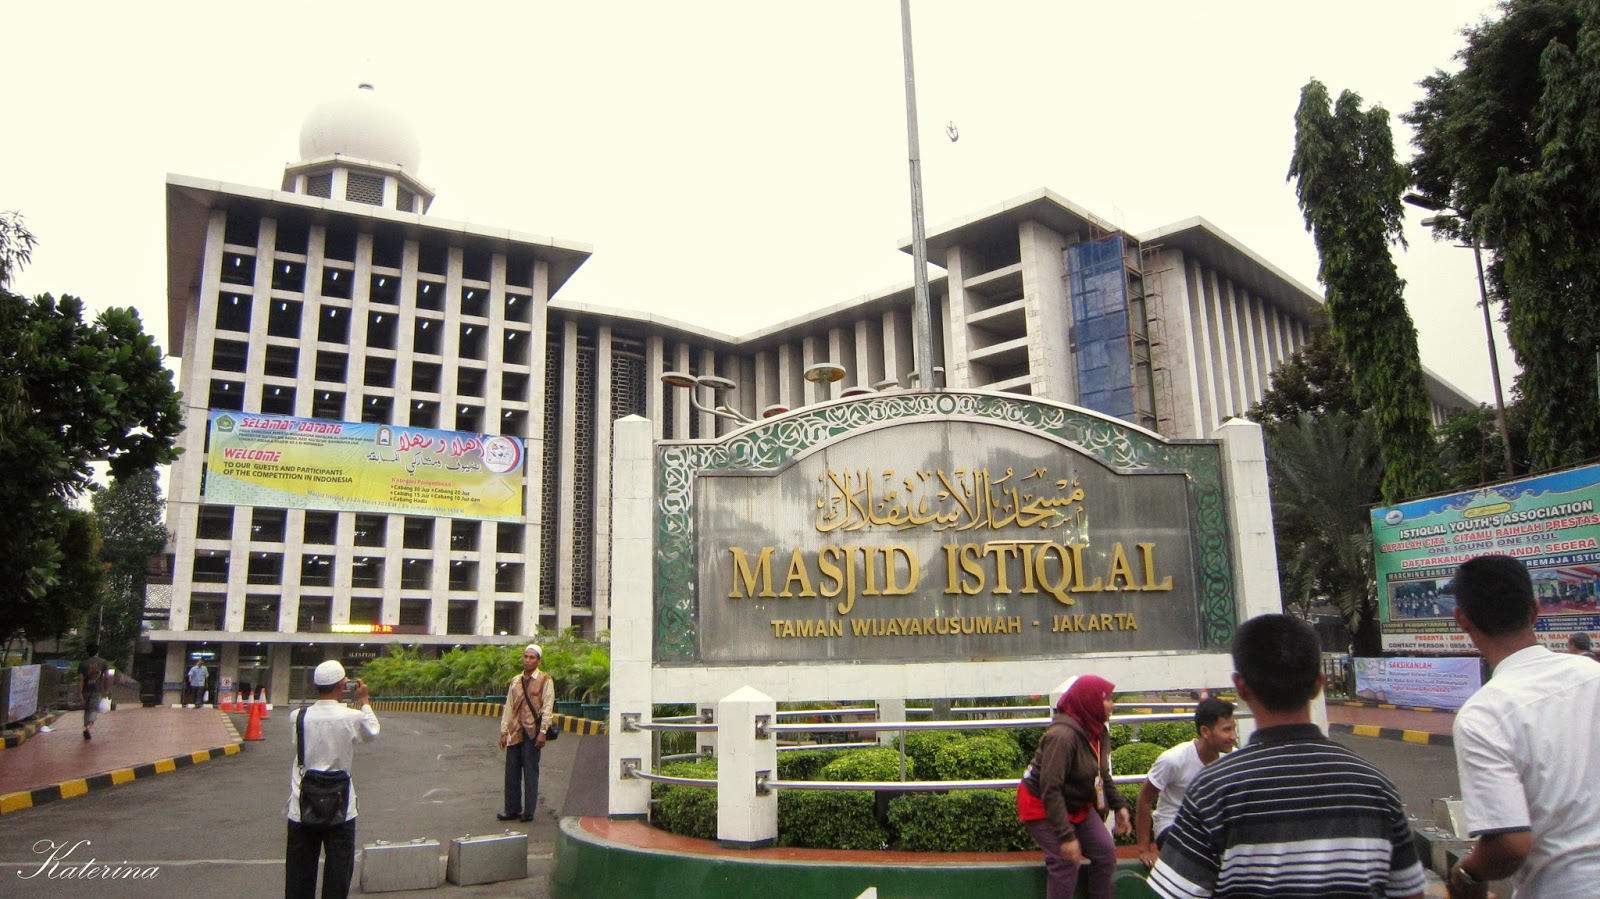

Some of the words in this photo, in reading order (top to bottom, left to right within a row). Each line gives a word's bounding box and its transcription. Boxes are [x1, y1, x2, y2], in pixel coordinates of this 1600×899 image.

[240, 417, 297, 431] SELAMAT
[298, 421, 343, 435] DATANG
[224, 448, 282, 462] WELCOME
[252, 471, 301, 480] COMPETITION
[313, 474, 353, 484] INDONESIA
[254, 463, 279, 471] GUESTS
[296, 466, 343, 476] PARTICIPANTS
[393, 490, 413, 498] Cabang
[1400, 524, 1447, 539] ISTIQLAL
[1449, 515, 1500, 532] YOUTH'S
[1503, 500, 1593, 525] ASSOCIATION
[1424, 537, 1446, 547] CITA
[1453, 530, 1492, 542] CITAMU
[1496, 523, 1543, 537] RAIHLAH
[1545, 513, 1600, 531] PRESTAS
[1428, 546, 1451, 554] ONE
[1454, 541, 1493, 552] SOUND
[1497, 537, 1522, 546] ONE
[1526, 533, 1558, 542] SOUL
[1509, 546, 1541, 557] ANDA
[1545, 539, 1597, 553] SEGERA
[1526, 556, 1569, 567] REMAJA
[728, 544, 921, 615] MASJID
[943, 540, 1173, 606] ISTIQLAL
[770, 618, 843, 638] TAMAN
[851, 614, 1022, 637] WIJAYAKUSUMAH
[1052, 612, 1138, 633] JAKARTA
